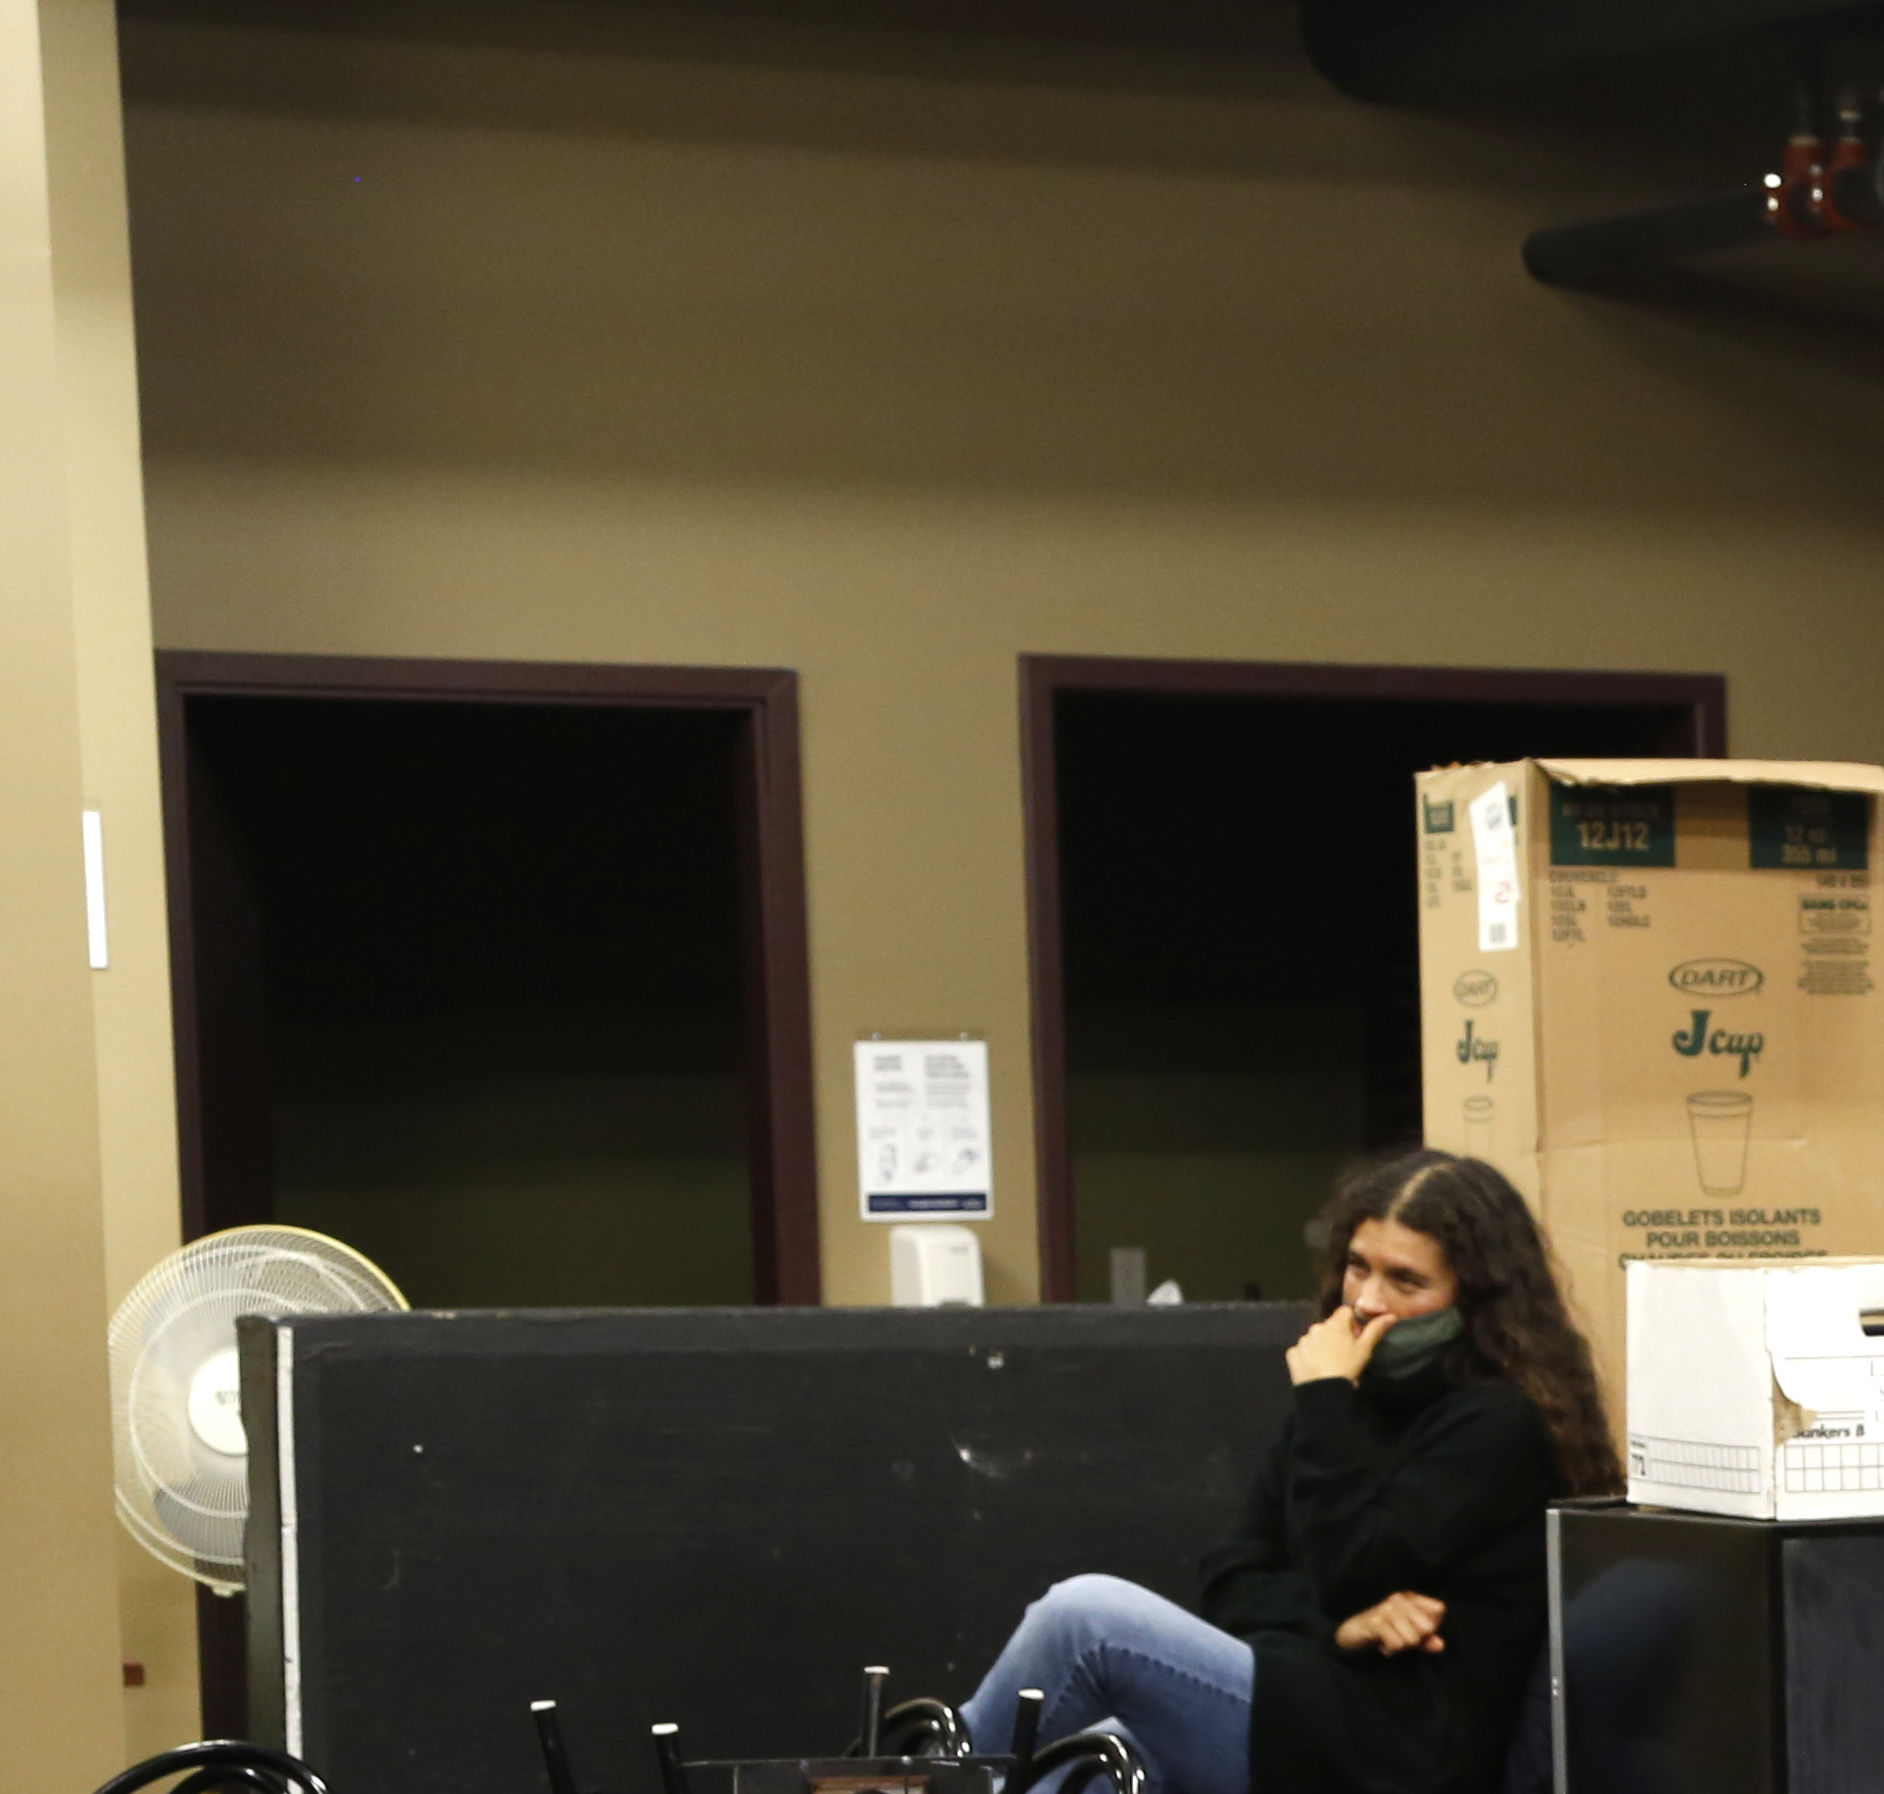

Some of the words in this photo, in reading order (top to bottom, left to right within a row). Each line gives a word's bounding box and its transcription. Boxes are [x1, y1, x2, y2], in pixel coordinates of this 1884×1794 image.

[1577, 821, 1650, 851] 12J12
[1680, 968, 1749, 987] DART
[1623, 1209, 1724, 1227] GOBELETS
[1729, 1208, 1821, 1226] ISOLANTS
[1646, 1230, 1700, 1248] POUR
[1705, 1229, 1801, 1247] BOISSONS
